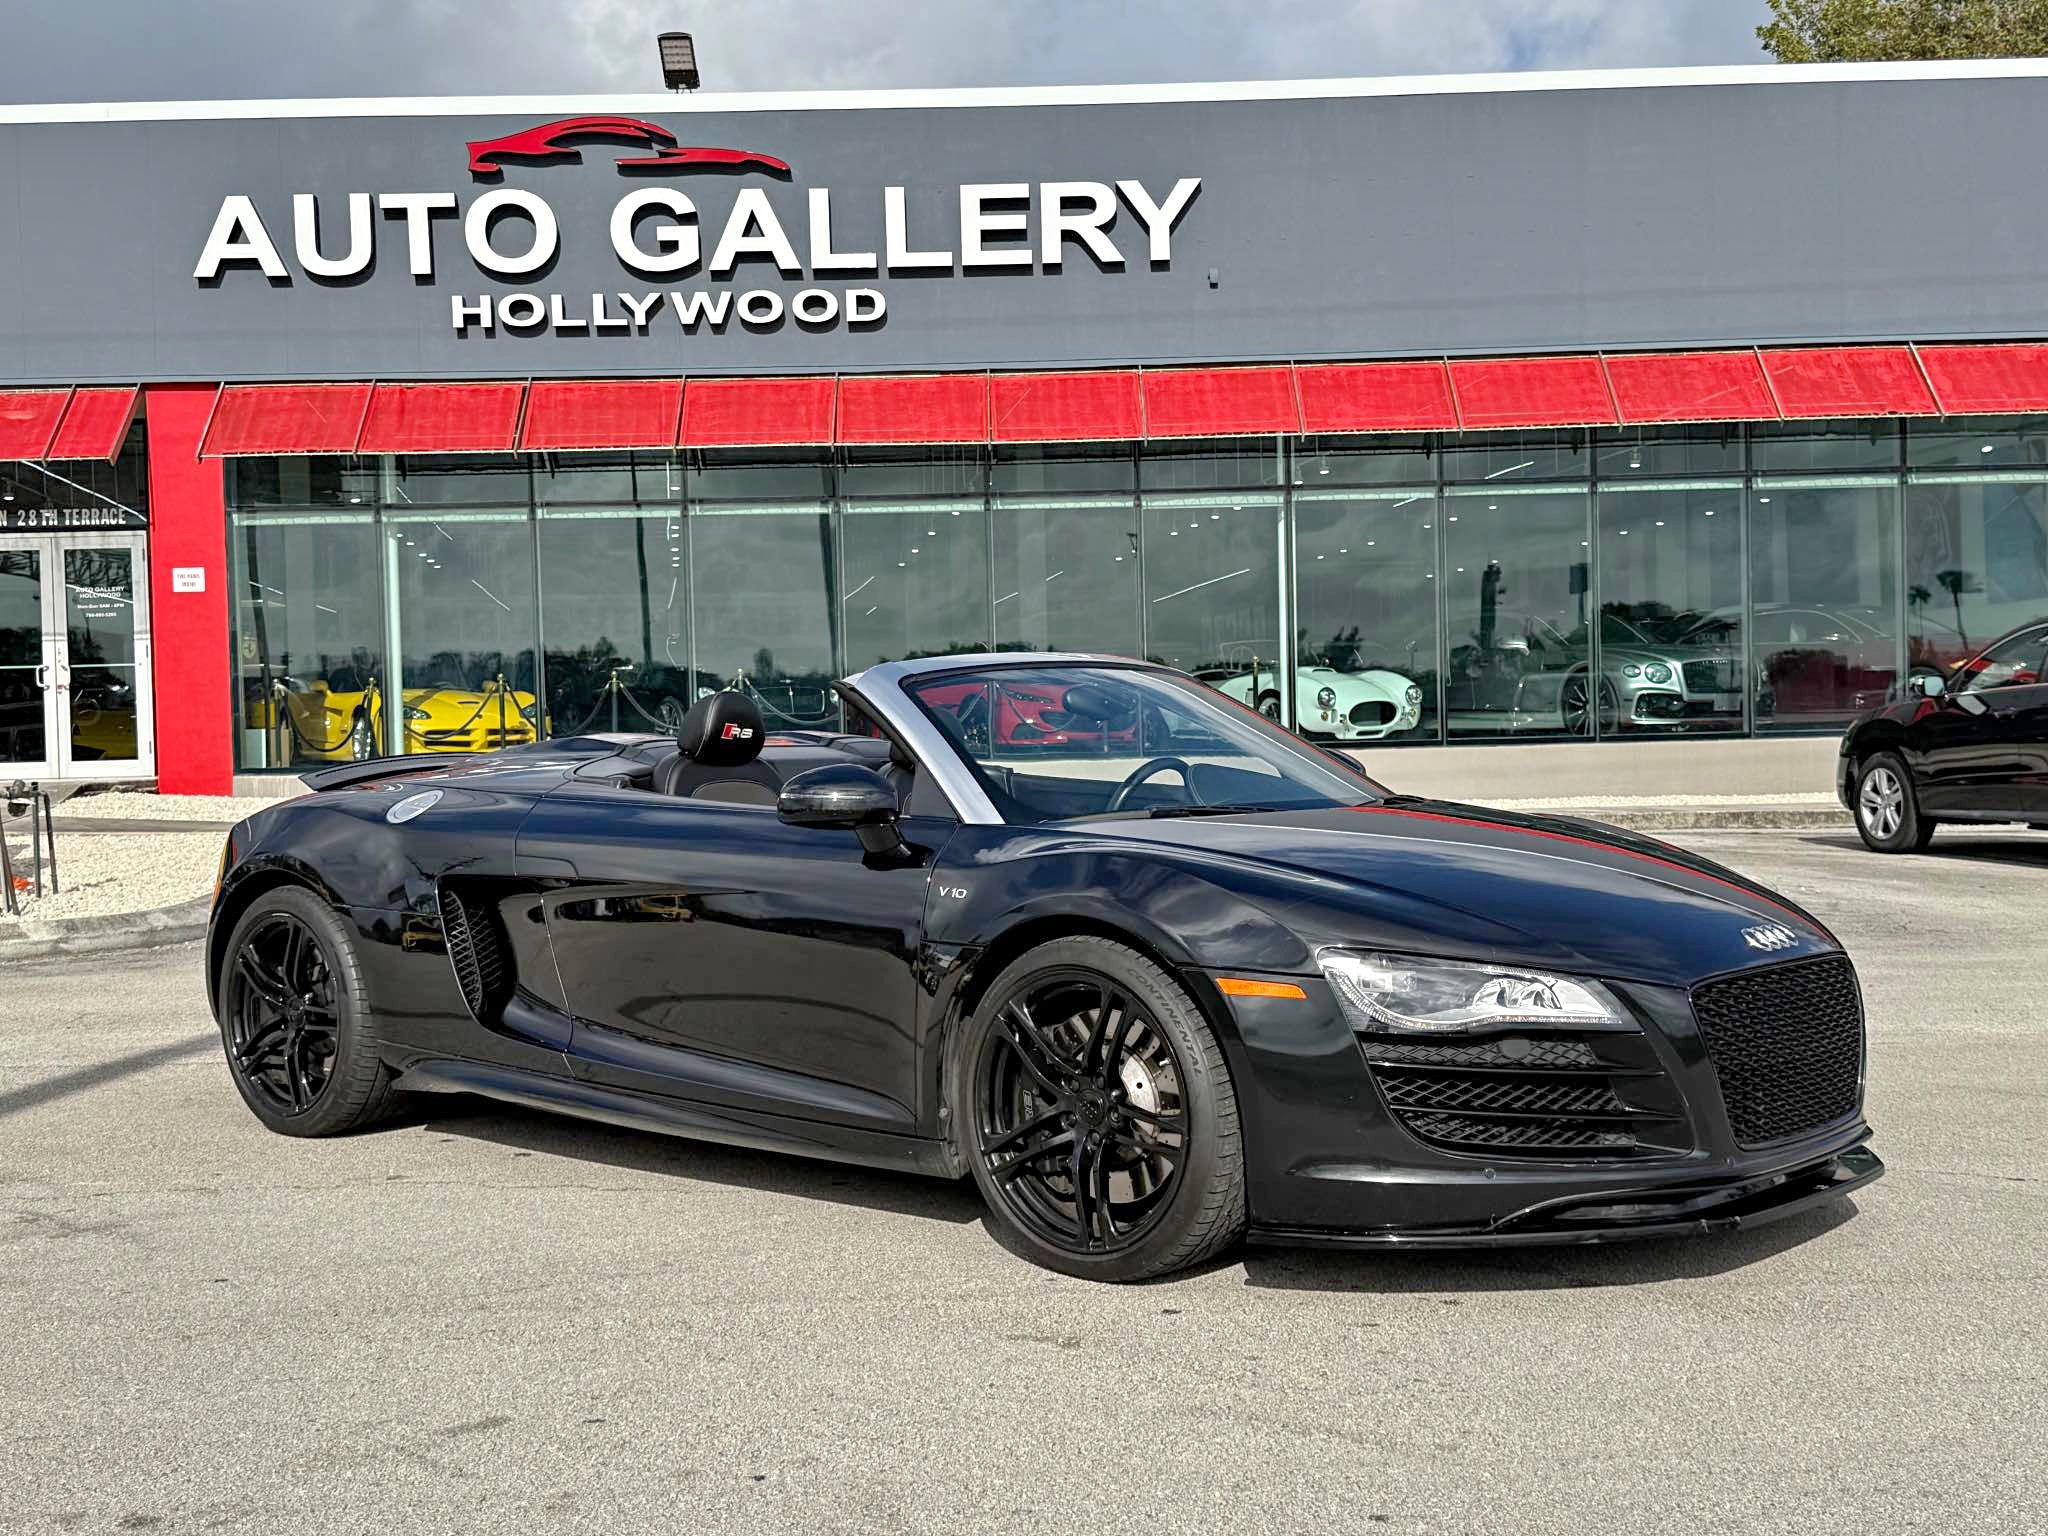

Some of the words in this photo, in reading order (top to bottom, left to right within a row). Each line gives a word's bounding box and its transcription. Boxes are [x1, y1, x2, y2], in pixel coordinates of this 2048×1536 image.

[194, 188, 559, 281] AUTO
[609, 178, 1201, 275] GALLERY
[451, 288, 887, 331] HOLLYWOOD
[17, 509, 58, 526] 28TH
[63, 508, 127, 526] TERRACE
[728, 726, 754, 739] R8
[1127, 968, 1205, 1076] CONTINENTAL
